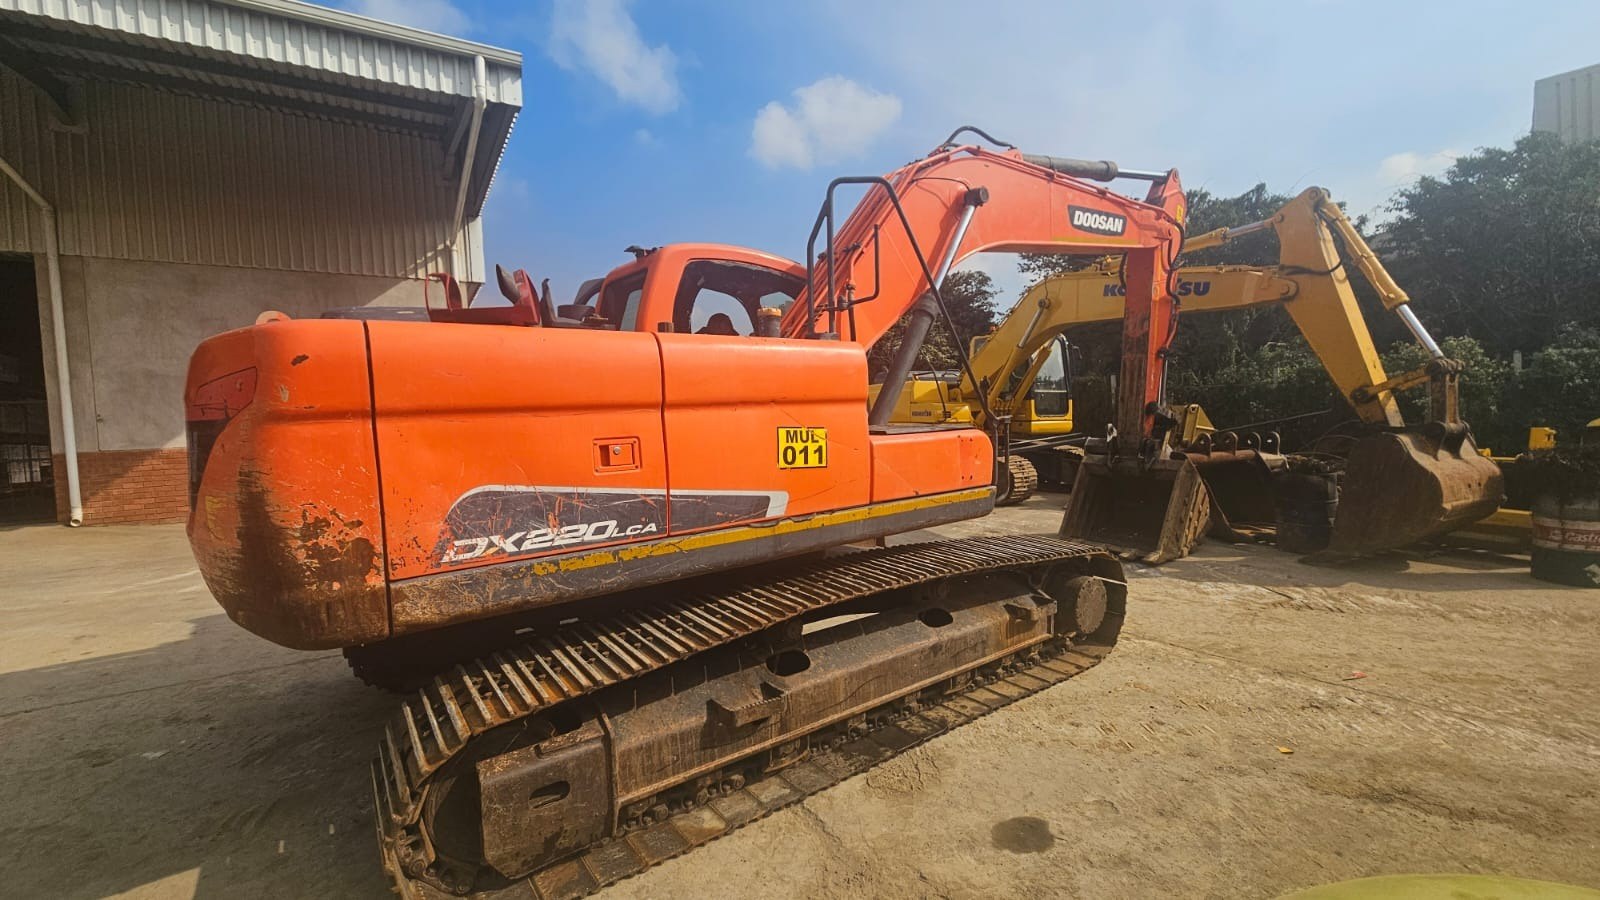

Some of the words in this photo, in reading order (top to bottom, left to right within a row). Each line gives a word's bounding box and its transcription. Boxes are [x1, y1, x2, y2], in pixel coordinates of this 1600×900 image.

[1073, 210, 1124, 233] DOOSAN
[785, 429, 820, 444] MUL
[783, 445, 823, 466] 011
